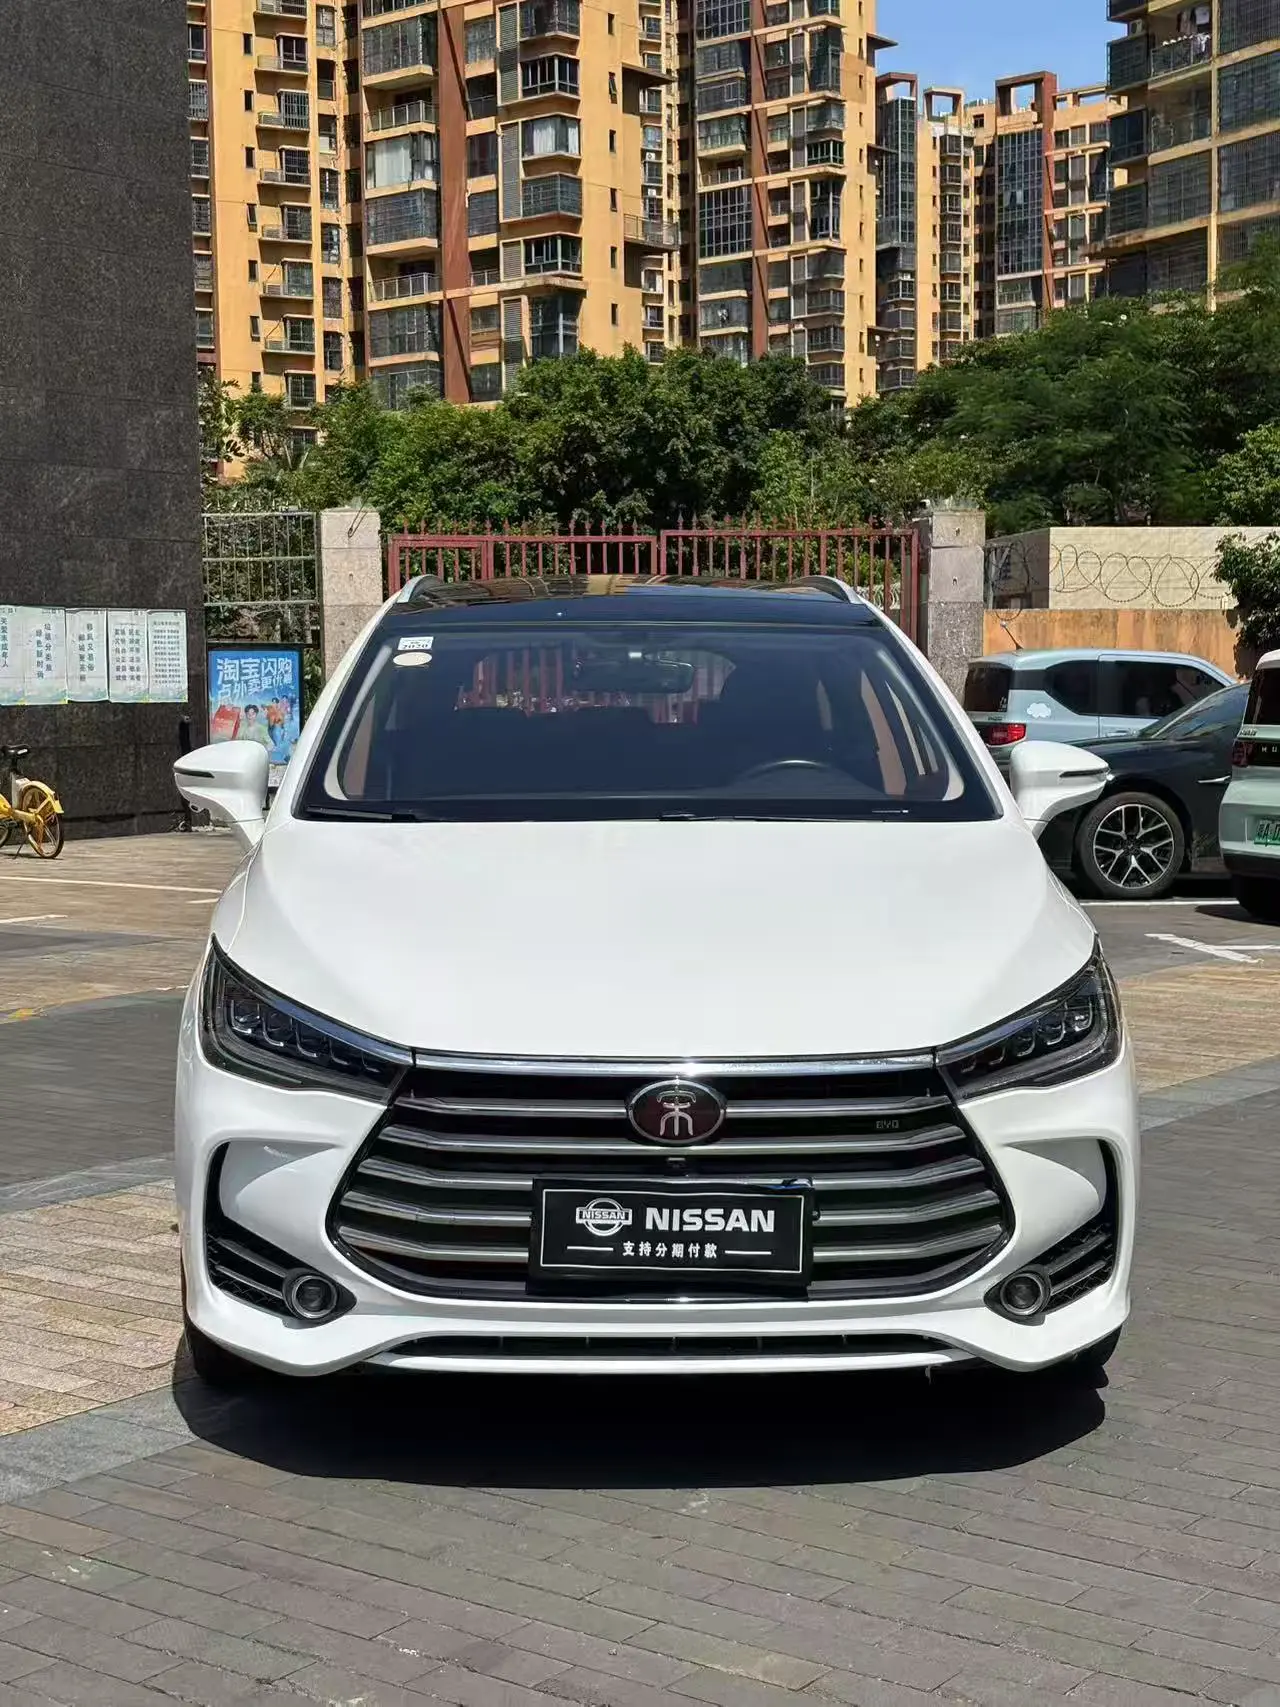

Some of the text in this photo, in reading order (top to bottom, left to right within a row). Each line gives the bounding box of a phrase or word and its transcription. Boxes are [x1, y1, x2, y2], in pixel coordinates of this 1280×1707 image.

[216, 657, 293, 685] 淘宝闪购
[876, 1120, 899, 1129] BYD
[581, 1207, 775, 1233] NISSAN NISSAN
[622, 1240, 718, 1259] 支持分期付款
